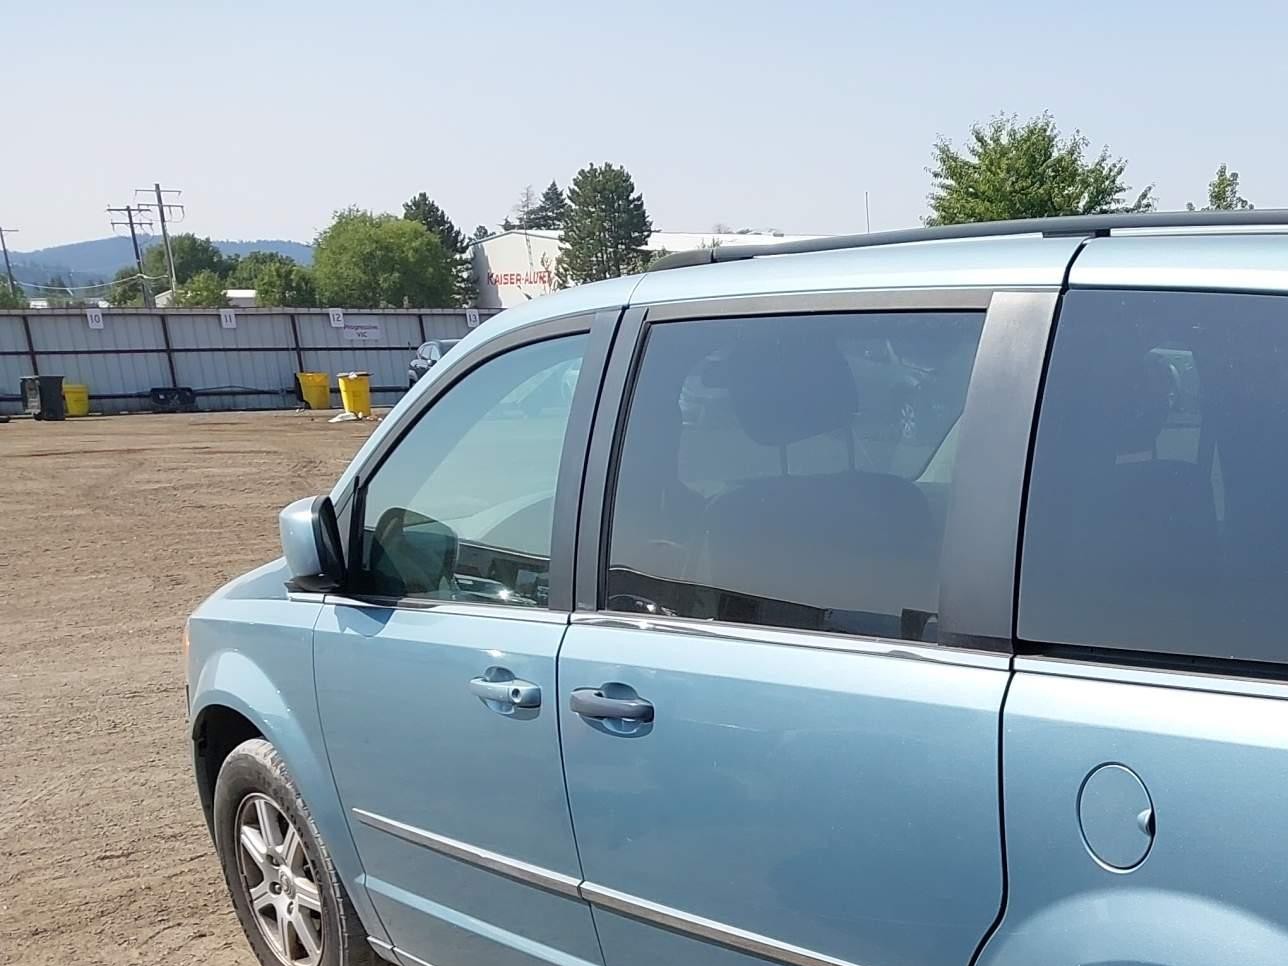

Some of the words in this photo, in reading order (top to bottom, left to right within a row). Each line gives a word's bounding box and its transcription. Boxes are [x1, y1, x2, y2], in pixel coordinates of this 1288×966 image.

[89, 313, 101, 324] 10
[223, 313, 233, 324] 11
[332, 313, 342, 322] 12
[468, 312, 478, 321] 13
